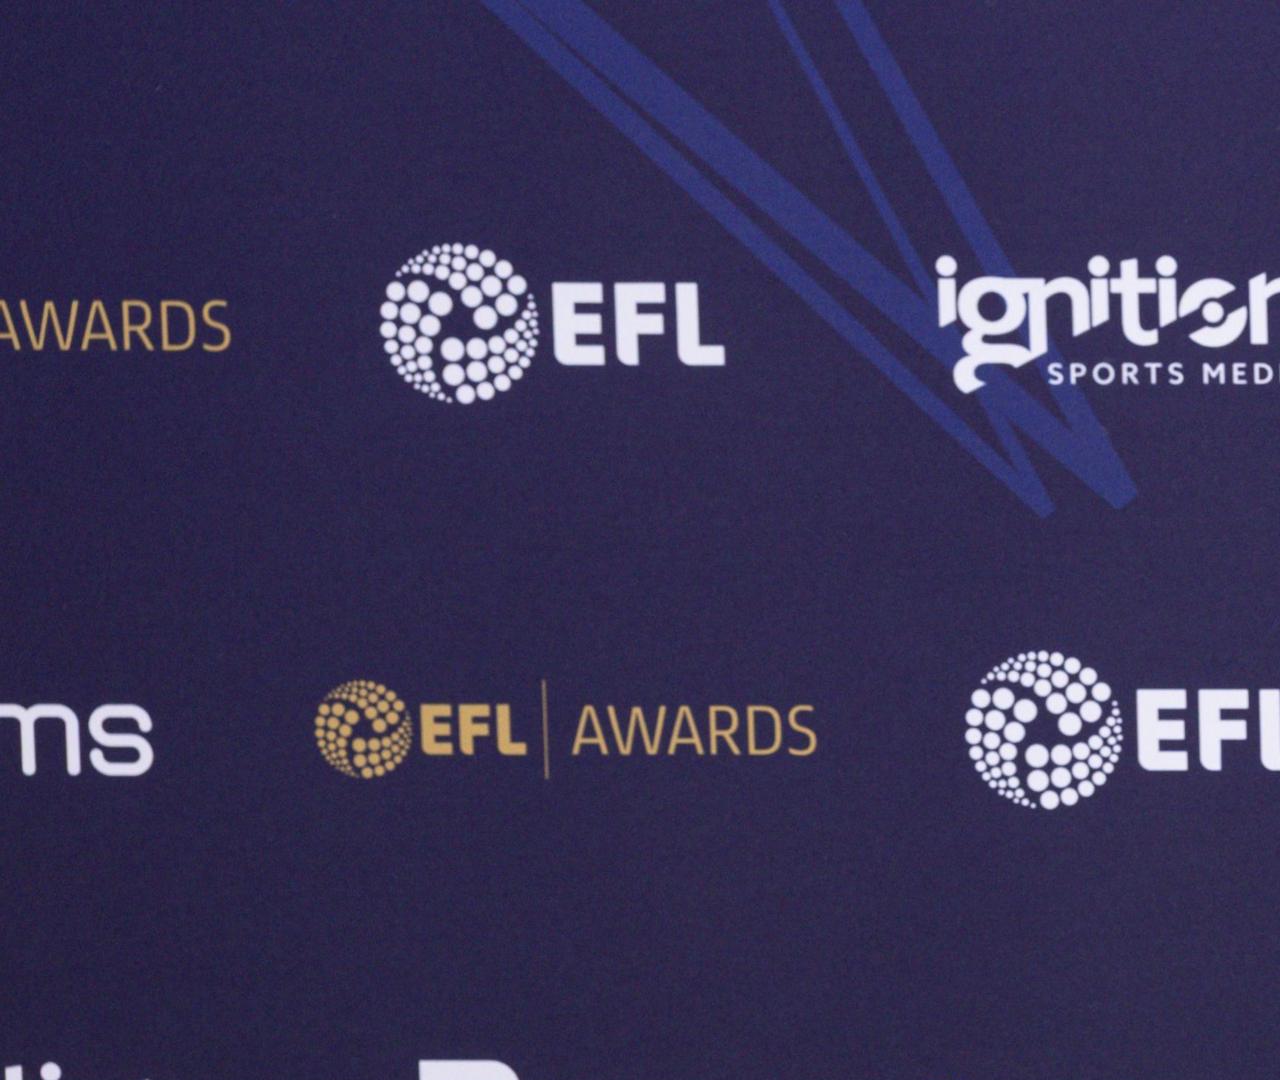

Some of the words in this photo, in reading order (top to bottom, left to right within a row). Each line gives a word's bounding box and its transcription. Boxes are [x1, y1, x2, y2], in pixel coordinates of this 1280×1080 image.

[551, 282, 725, 366] EFL
[1047, 362, 1184, 385] SPORTS
[420, 703, 528, 756] EFL
[572, 704, 817, 757] AWARDS
